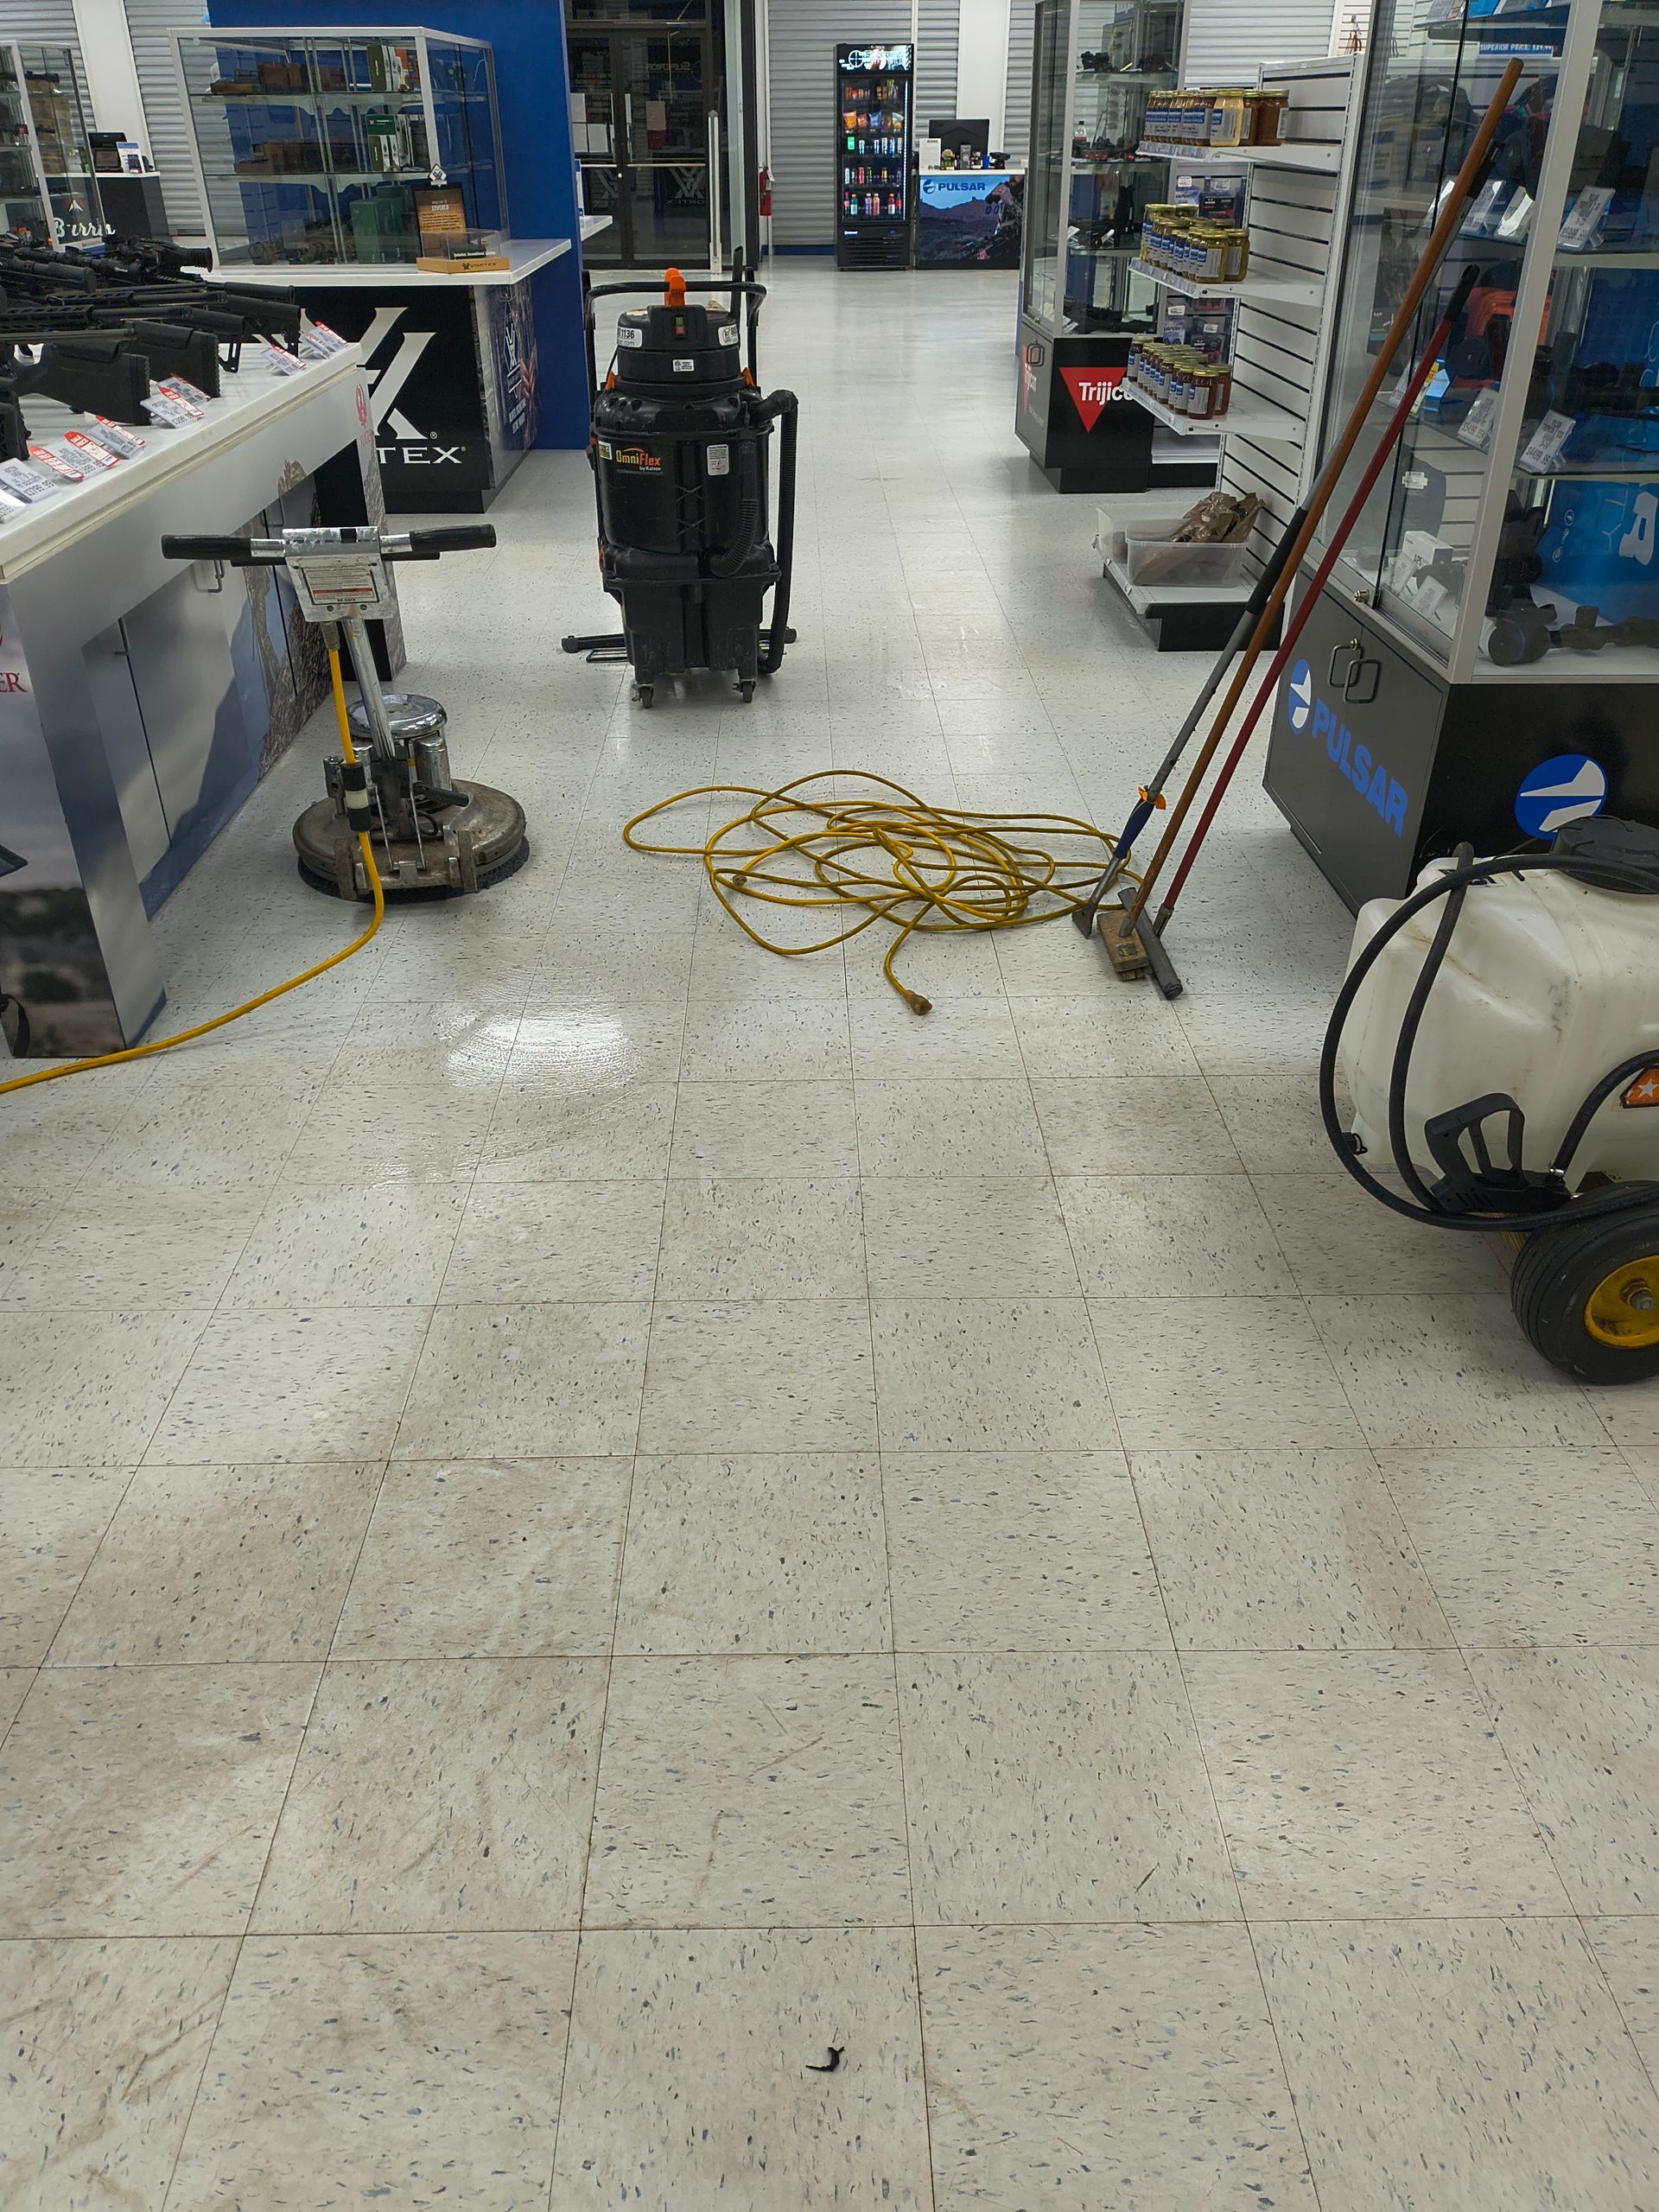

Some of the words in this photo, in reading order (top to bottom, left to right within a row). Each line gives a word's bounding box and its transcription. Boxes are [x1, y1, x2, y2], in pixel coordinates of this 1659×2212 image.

[938, 182, 985, 191] PULSAR
[1078, 382, 1133, 405] Trijic
[377, 447, 462, 464] TEX
[615, 449, 661, 466] OmniFlex
[1312, 698, 1408, 837] PULSAR
